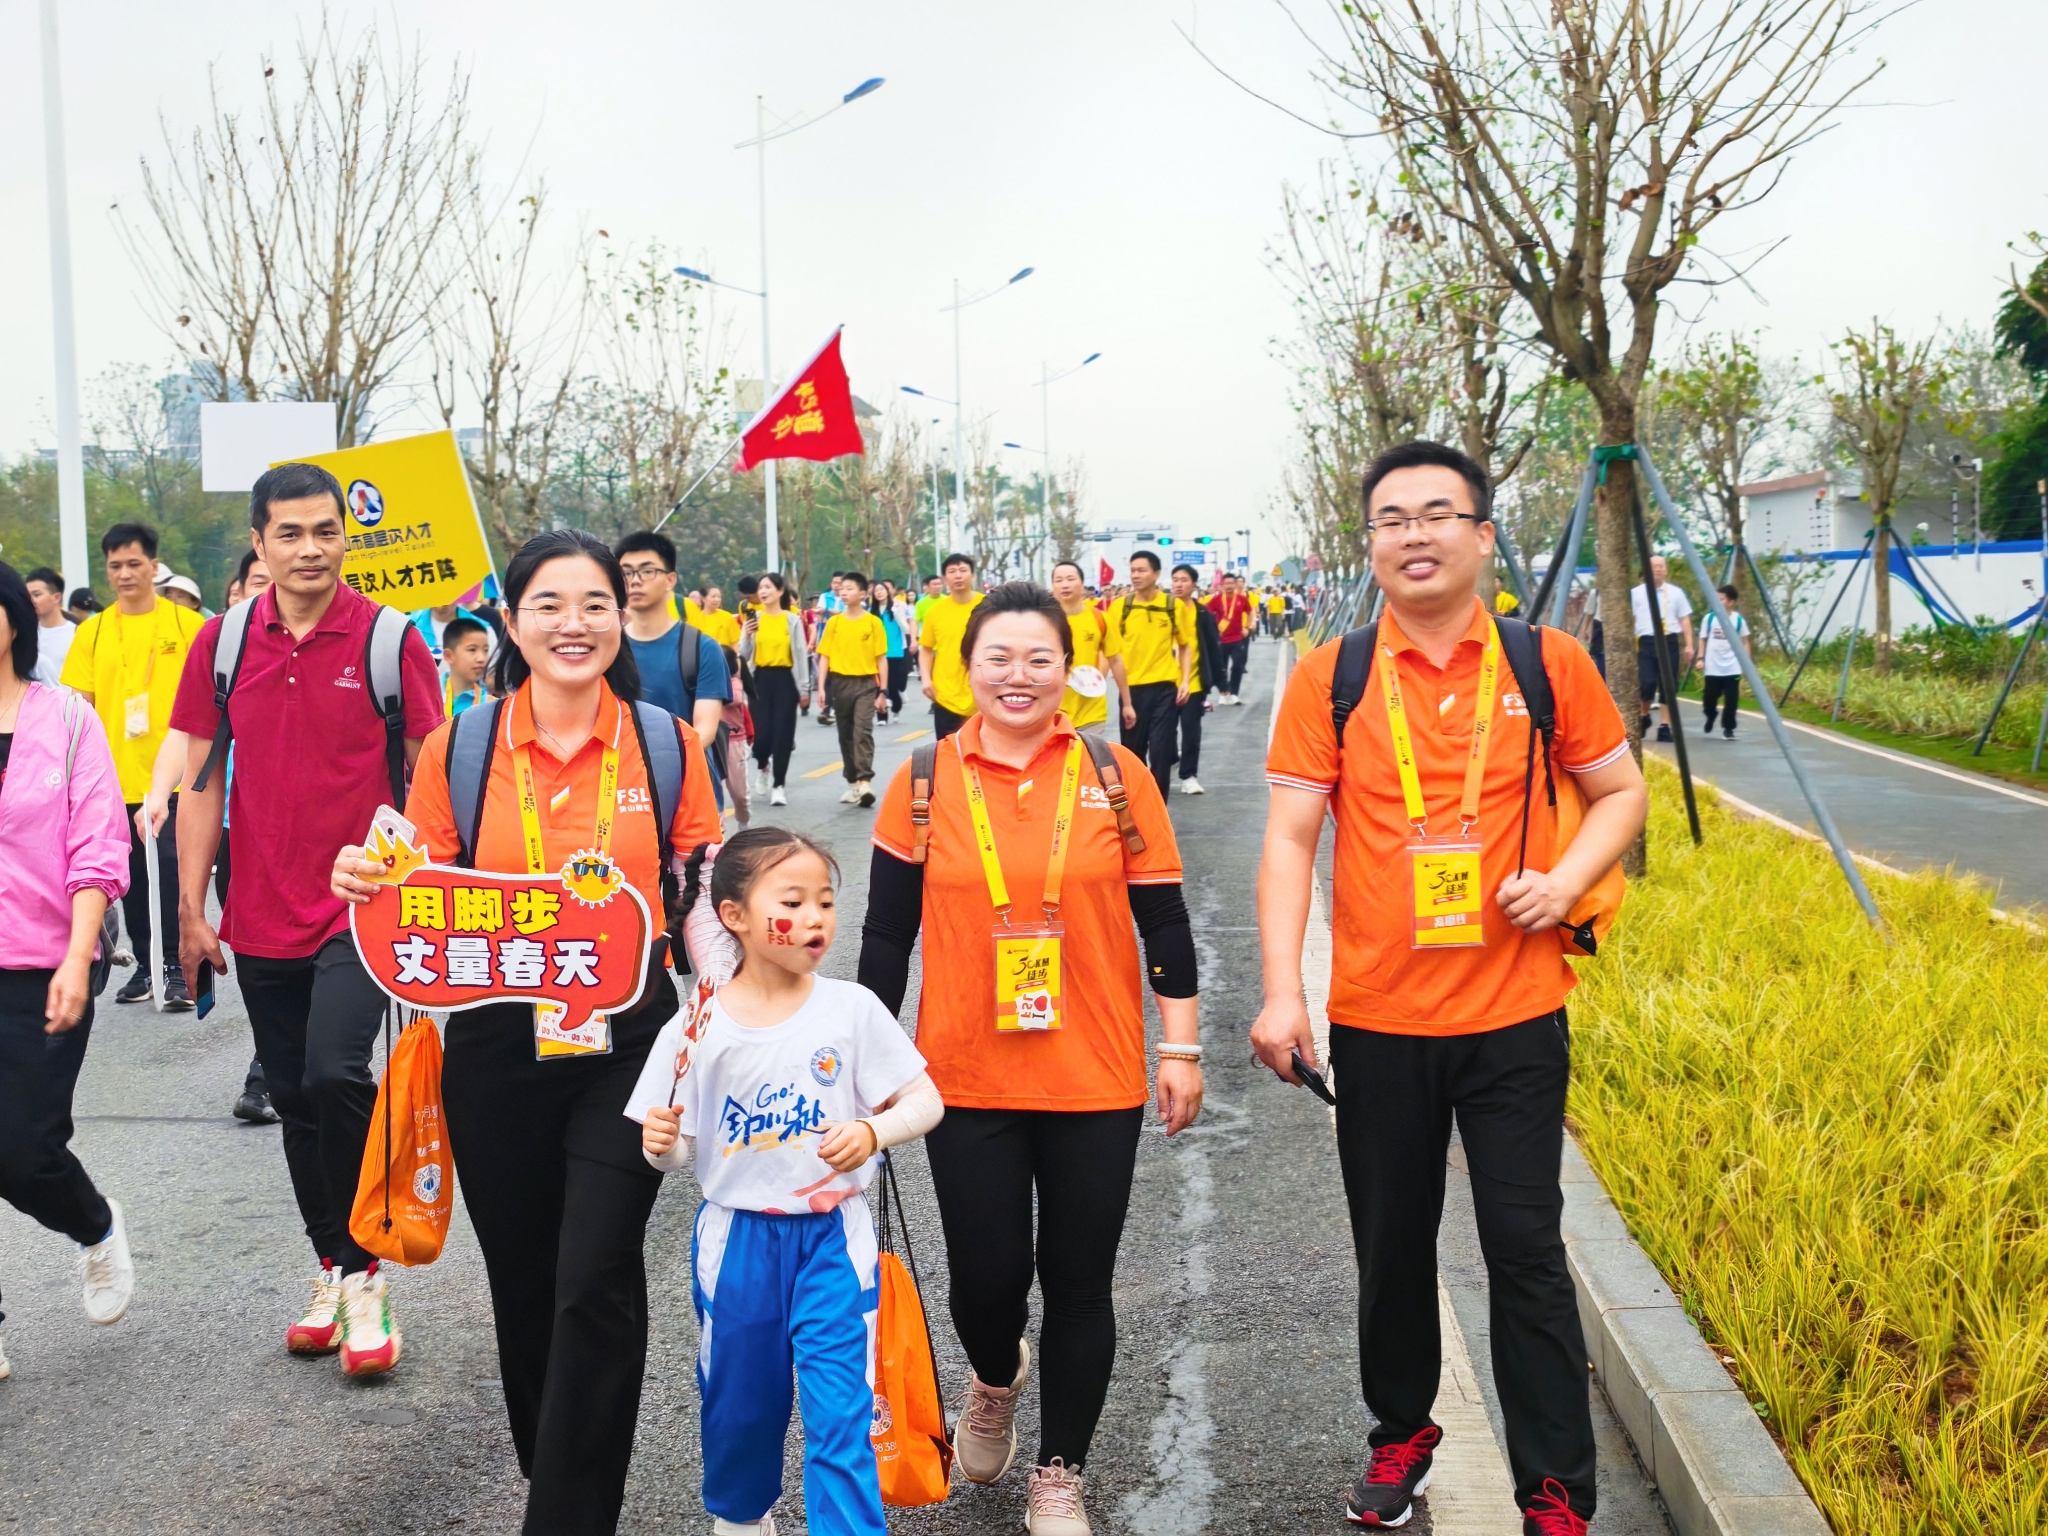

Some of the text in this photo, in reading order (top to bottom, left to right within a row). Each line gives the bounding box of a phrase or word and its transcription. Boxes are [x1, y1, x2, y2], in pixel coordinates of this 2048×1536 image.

[343, 558, 458, 594] 层次人才方阵
[1502, 692, 1526, 707] FS
[616, 788, 650, 804] FSL
[1081, 785, 1109, 801] FSL
[398, 884, 563, 935] 用脚步
[767, 917, 774, 933] I
[768, 933, 794, 946] FSL
[391, 933, 601, 988] 丈量春天
[756, 1083, 795, 1108] Go!
[718, 1094, 832, 1146] 全力以赴
